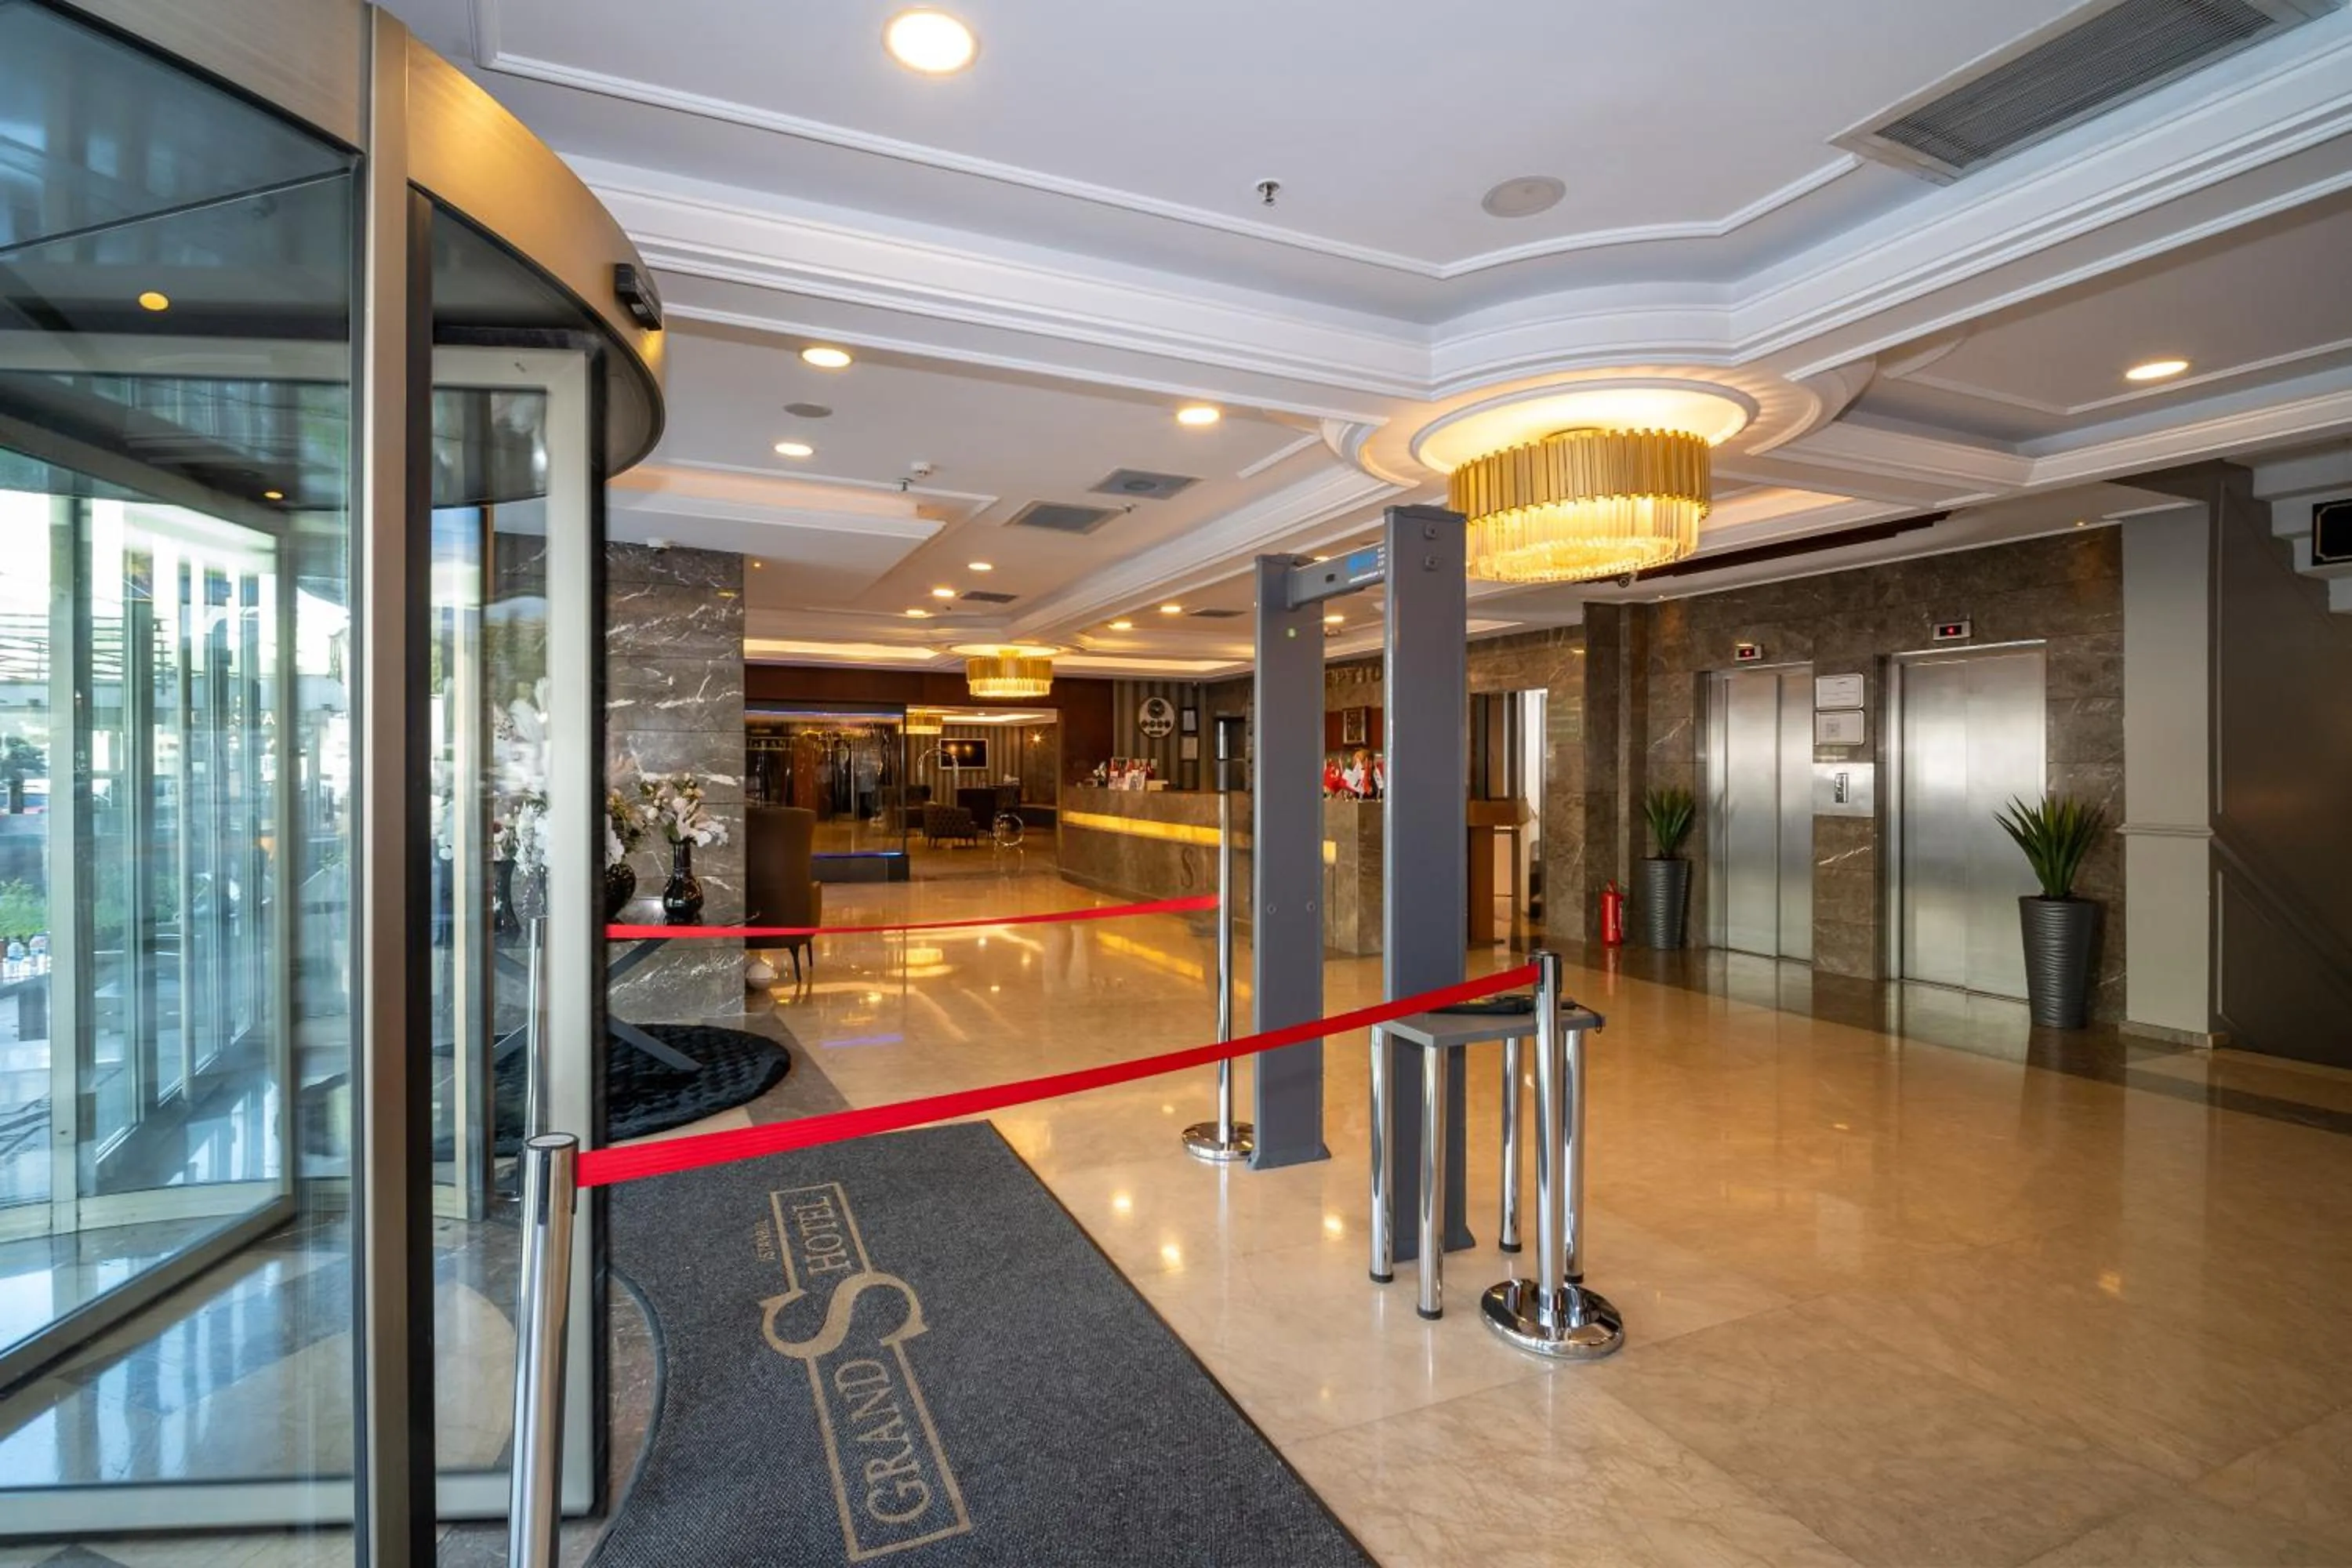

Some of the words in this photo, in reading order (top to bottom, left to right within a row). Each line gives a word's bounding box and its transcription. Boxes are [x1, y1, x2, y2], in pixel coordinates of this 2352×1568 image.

[1325, 665, 1383, 685] EPTIO
[792, 1196, 851, 1276] HOTEL
[759, 1272, 928, 1358] S
[834, 1359, 931, 1523] GRAND
